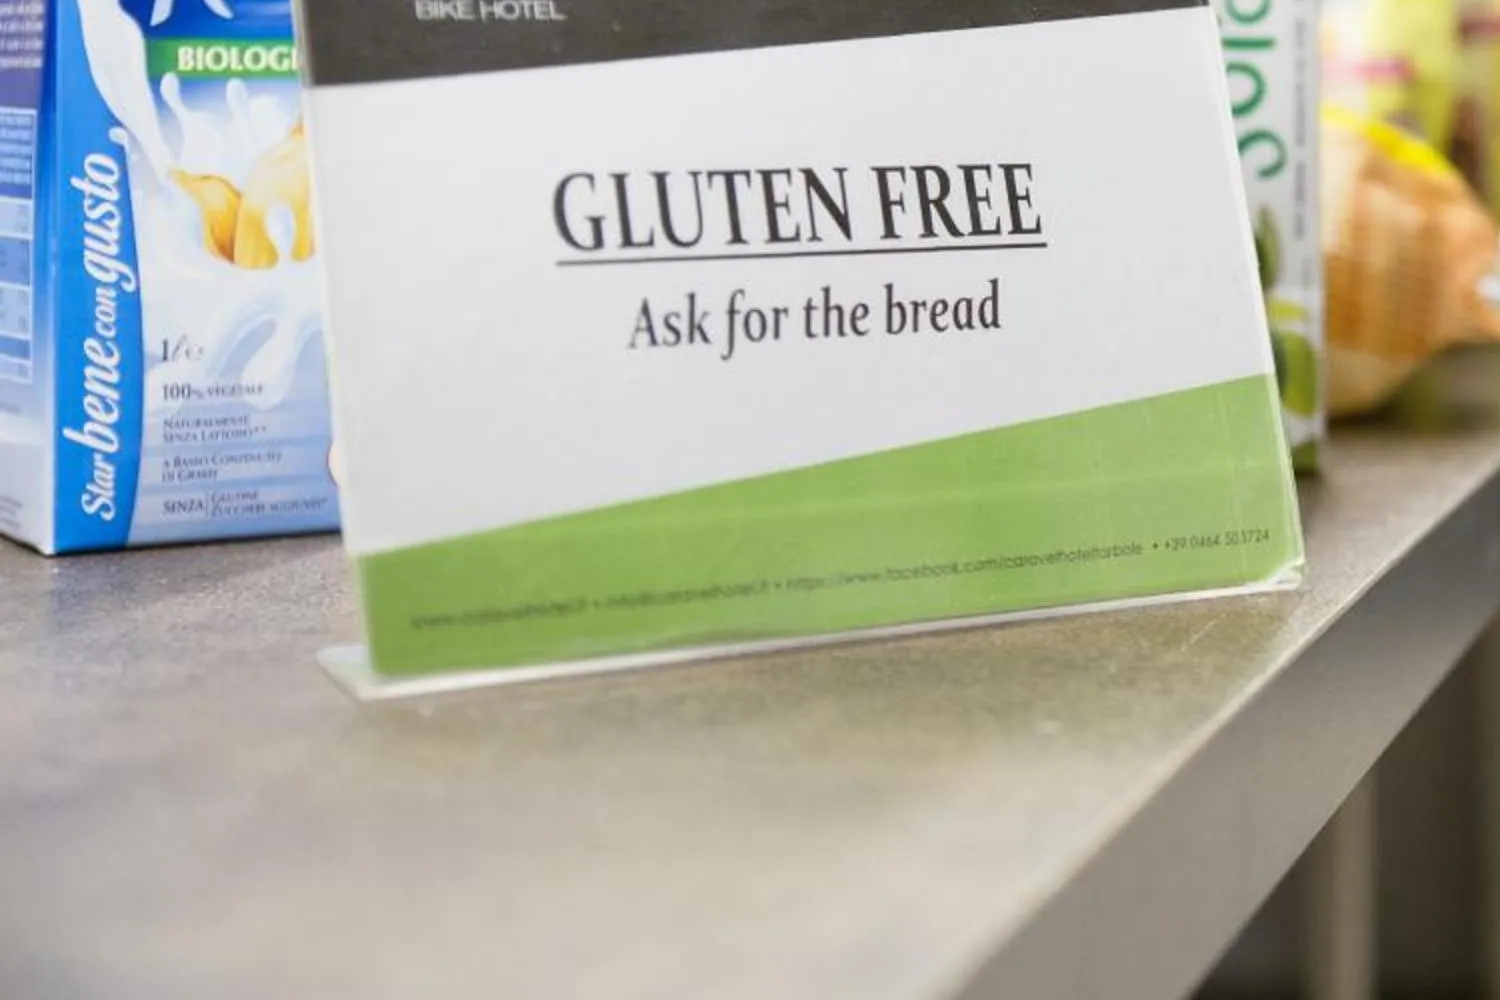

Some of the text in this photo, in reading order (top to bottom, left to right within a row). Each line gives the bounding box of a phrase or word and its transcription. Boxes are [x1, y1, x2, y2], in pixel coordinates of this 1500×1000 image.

[416, 0, 567, 22] BIKE HOTEL
[553, 163, 1042, 251] GLUTEN FREE
[63, 152, 137, 521] Star bene con gusto
[627, 278, 1002, 361] Ask for the bread
